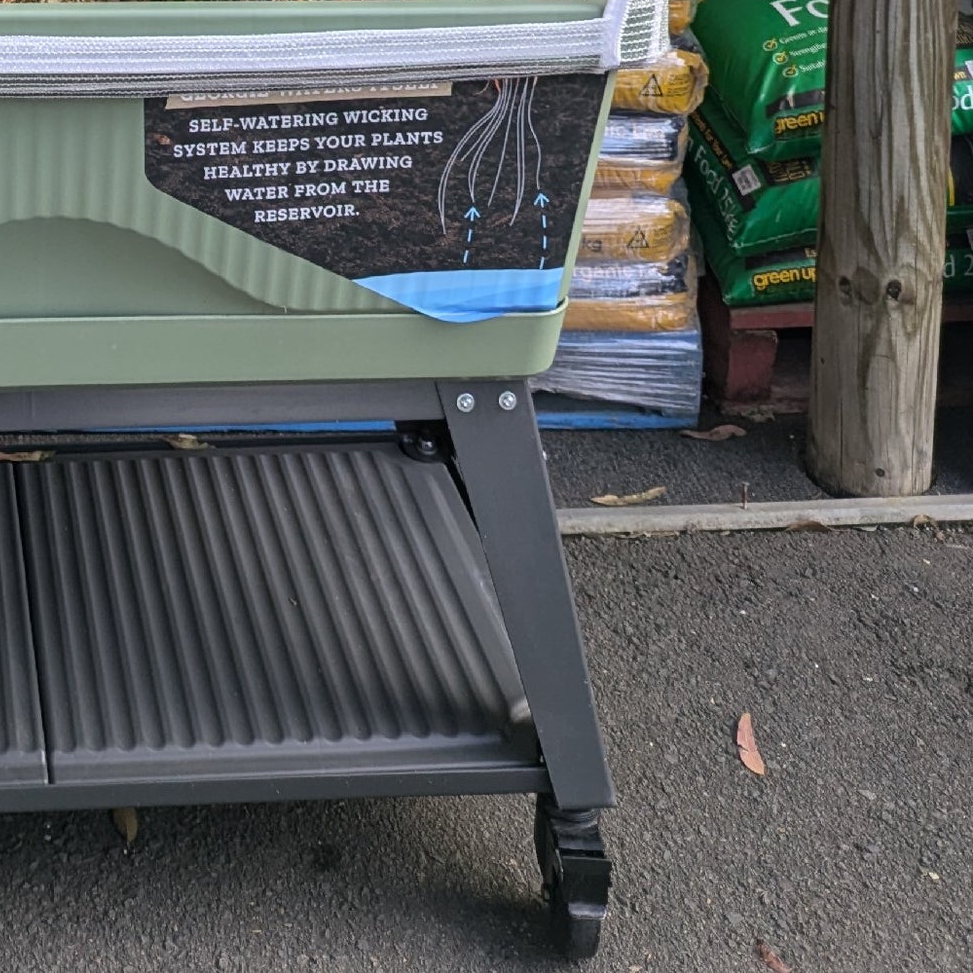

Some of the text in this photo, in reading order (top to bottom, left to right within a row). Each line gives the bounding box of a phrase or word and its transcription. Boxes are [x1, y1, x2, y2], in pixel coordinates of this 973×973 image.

[188, 107, 428, 133] SELF-WATERING WICKING
[775, 112, 817, 134] green
[173, 131, 444, 158] SYSTEM KEEPS YOUR PLANTS
[203, 156, 413, 181] HEALTHY BY DRAWING
[225, 179, 390, 202] WATER FROM THE
[254, 204, 360, 224] RESERVOIR.
[754, 269, 800, 290] green
